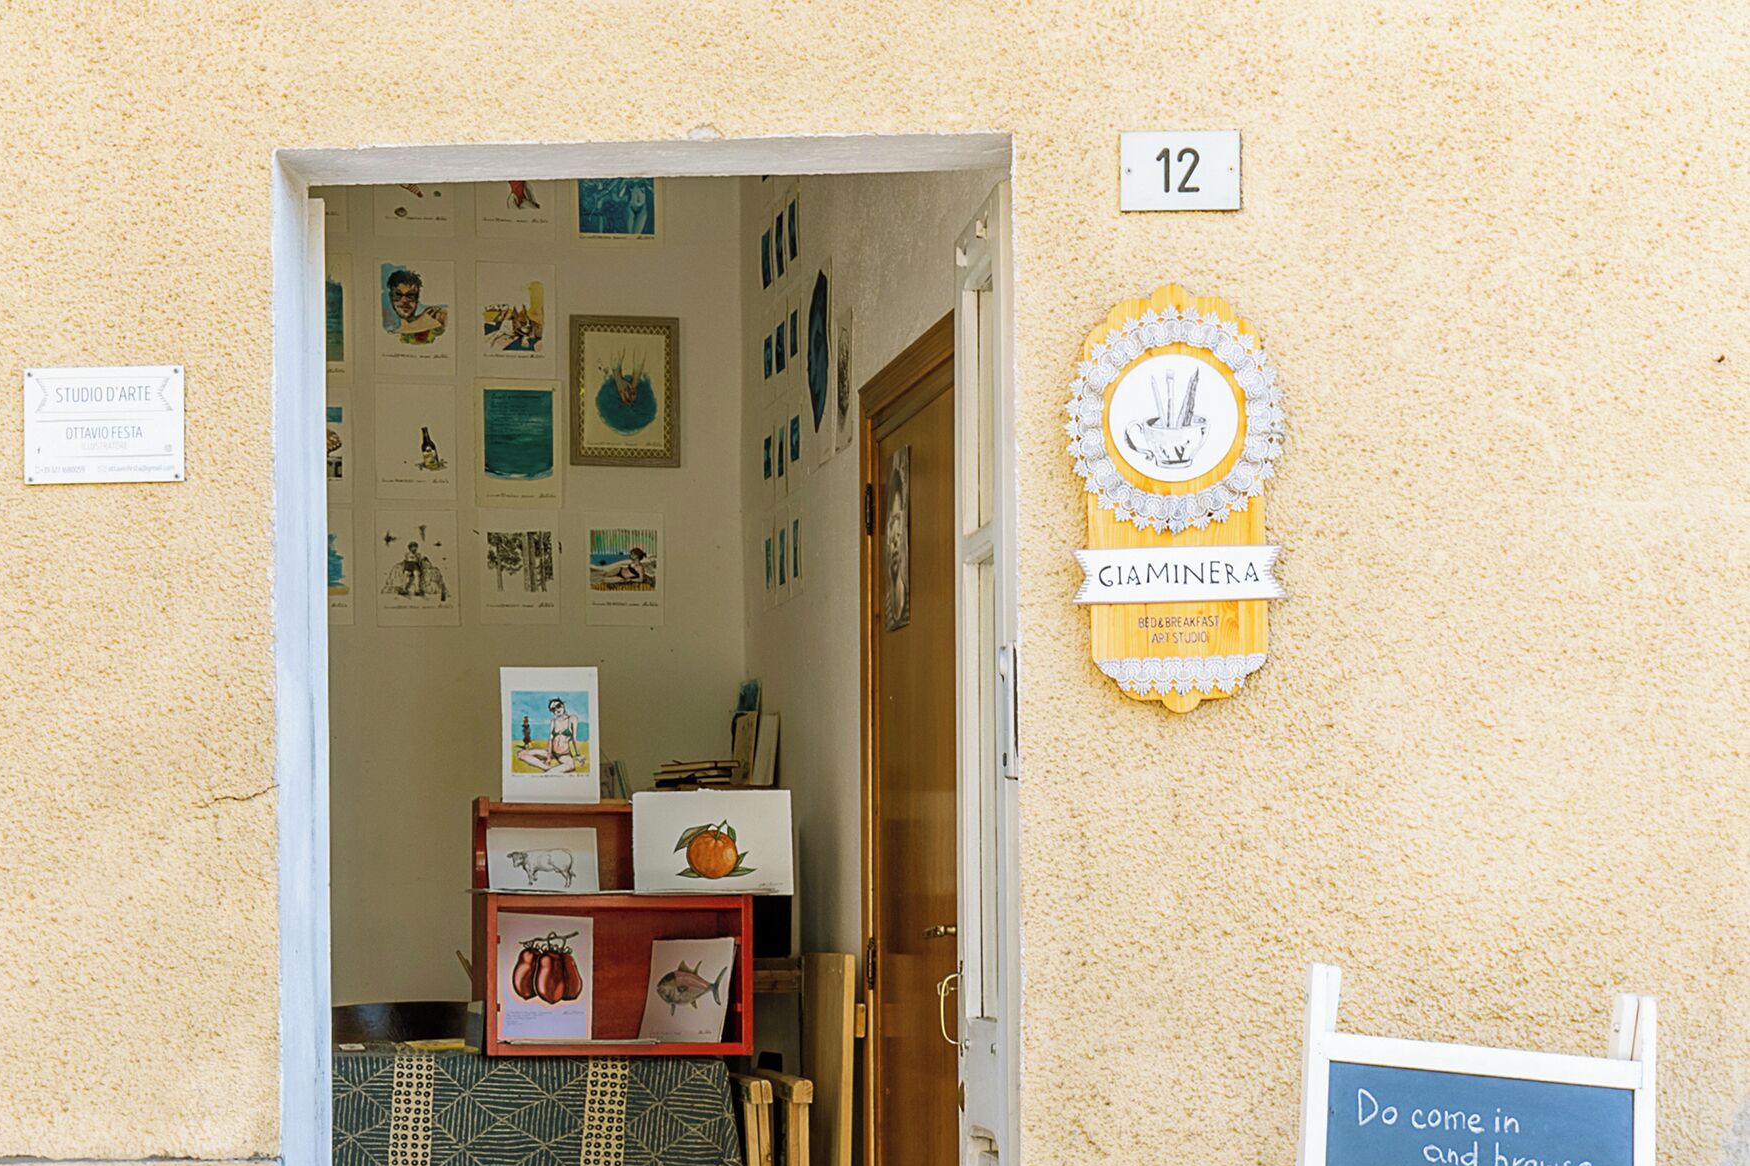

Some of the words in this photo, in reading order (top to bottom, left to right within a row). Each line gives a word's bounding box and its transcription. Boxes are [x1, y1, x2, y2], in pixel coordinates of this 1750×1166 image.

[1155, 147, 1200, 193] 12
[55, 386, 103, 403] STUDIO
[107, 385, 151, 402] D'ARTE
[65, 427, 109, 440] OTTAVIO
[111, 426, 143, 439] FESTA
[1098, 561, 1260, 587] GIAMINERA
[1138, 615, 1219, 628] BED&BREAKFAST
[1151, 632, 1170, 644] ART
[1172, 631, 1208, 643] STUDIO
[1357, 1088, 1398, 1126] Do
[1411, 1108, 1485, 1134] come
[1494, 1107, 1520, 1134] in
